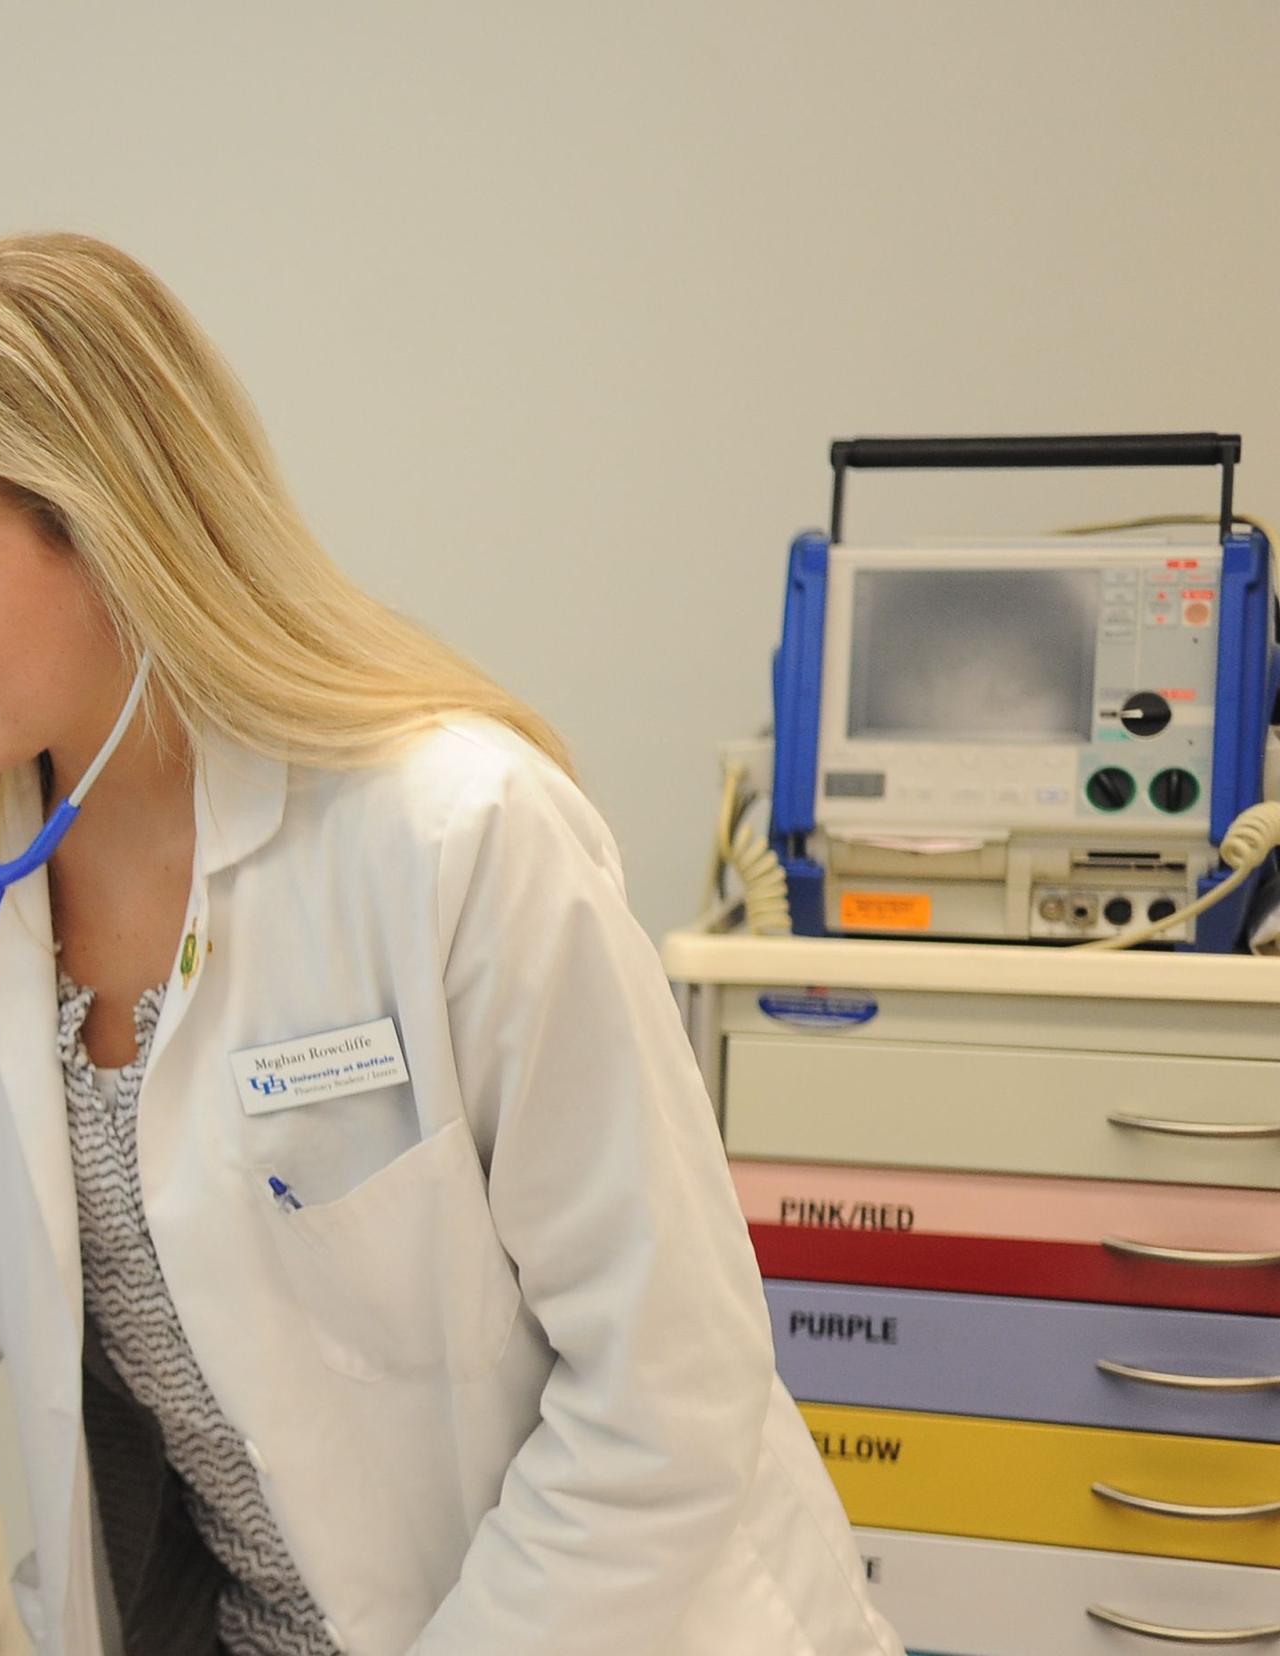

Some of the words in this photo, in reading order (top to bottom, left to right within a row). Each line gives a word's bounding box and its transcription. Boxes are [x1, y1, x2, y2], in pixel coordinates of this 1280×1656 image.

[254, 1051, 307, 1072] Meghan
[309, 1035, 373, 1060] Rowcliffe
[289, 1066, 341, 1085] University
[356, 1054, 396, 1071] Buffalo
[780, 1199, 915, 1232] PINK/RED
[790, 1311, 897, 1344] PURPLE
